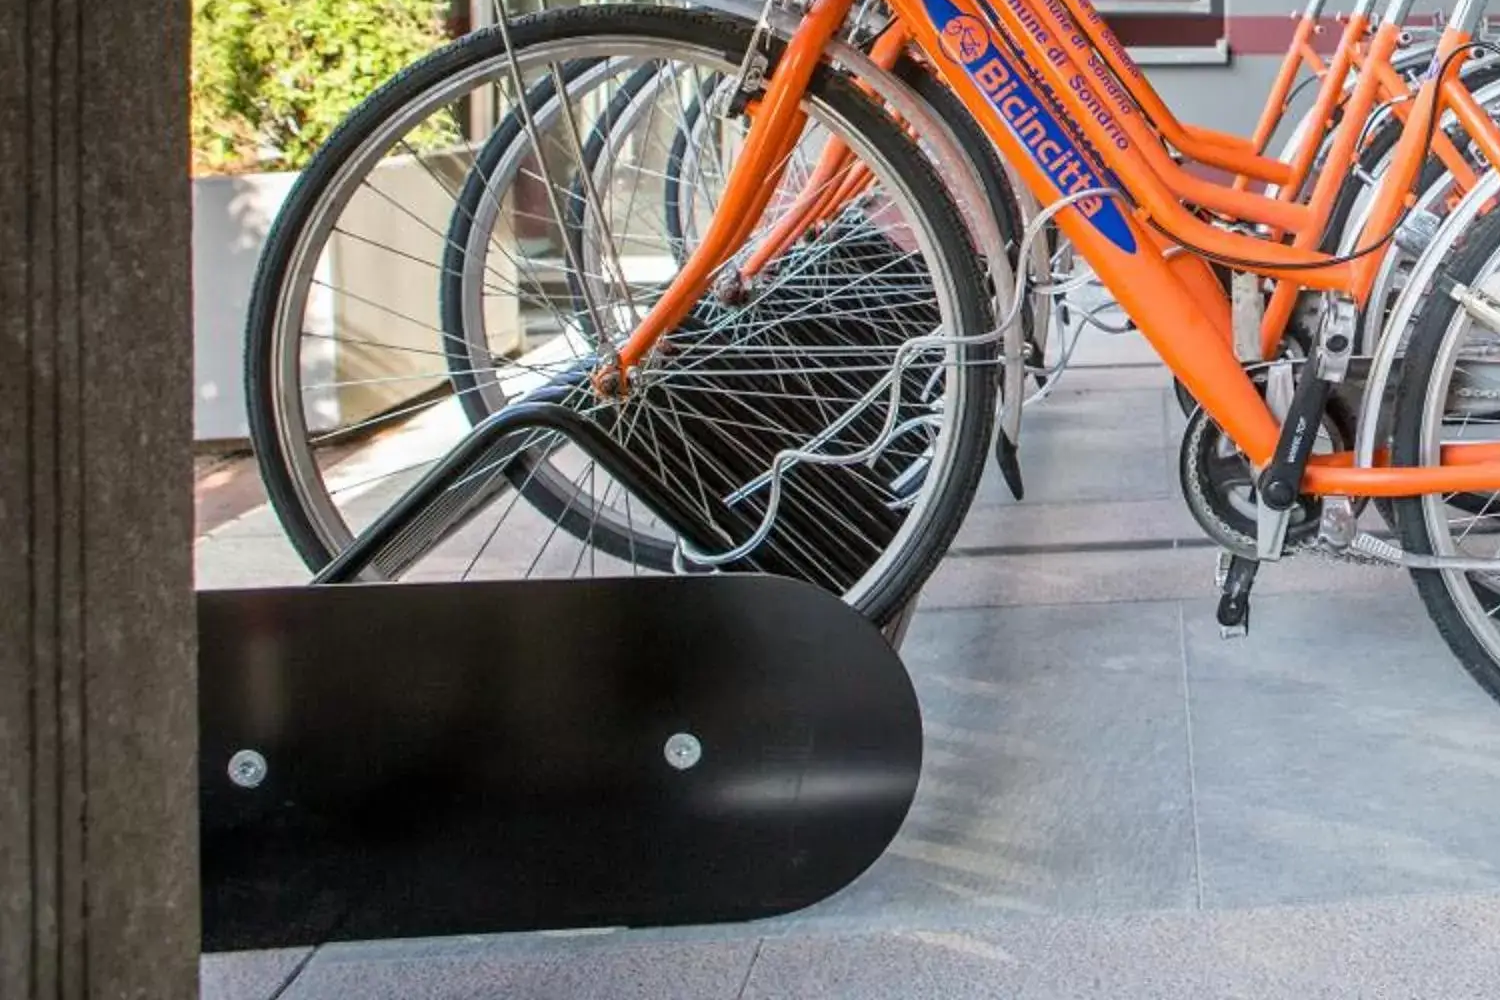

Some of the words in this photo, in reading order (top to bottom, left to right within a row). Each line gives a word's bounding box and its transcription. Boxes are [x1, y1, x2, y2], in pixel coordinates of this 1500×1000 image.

[1048, 47, 1067, 67] di
[1069, 73, 1129, 151] Sondrio
[1071, 33, 1086, 50] di
[1087, 55, 1131, 115] Sondrio
